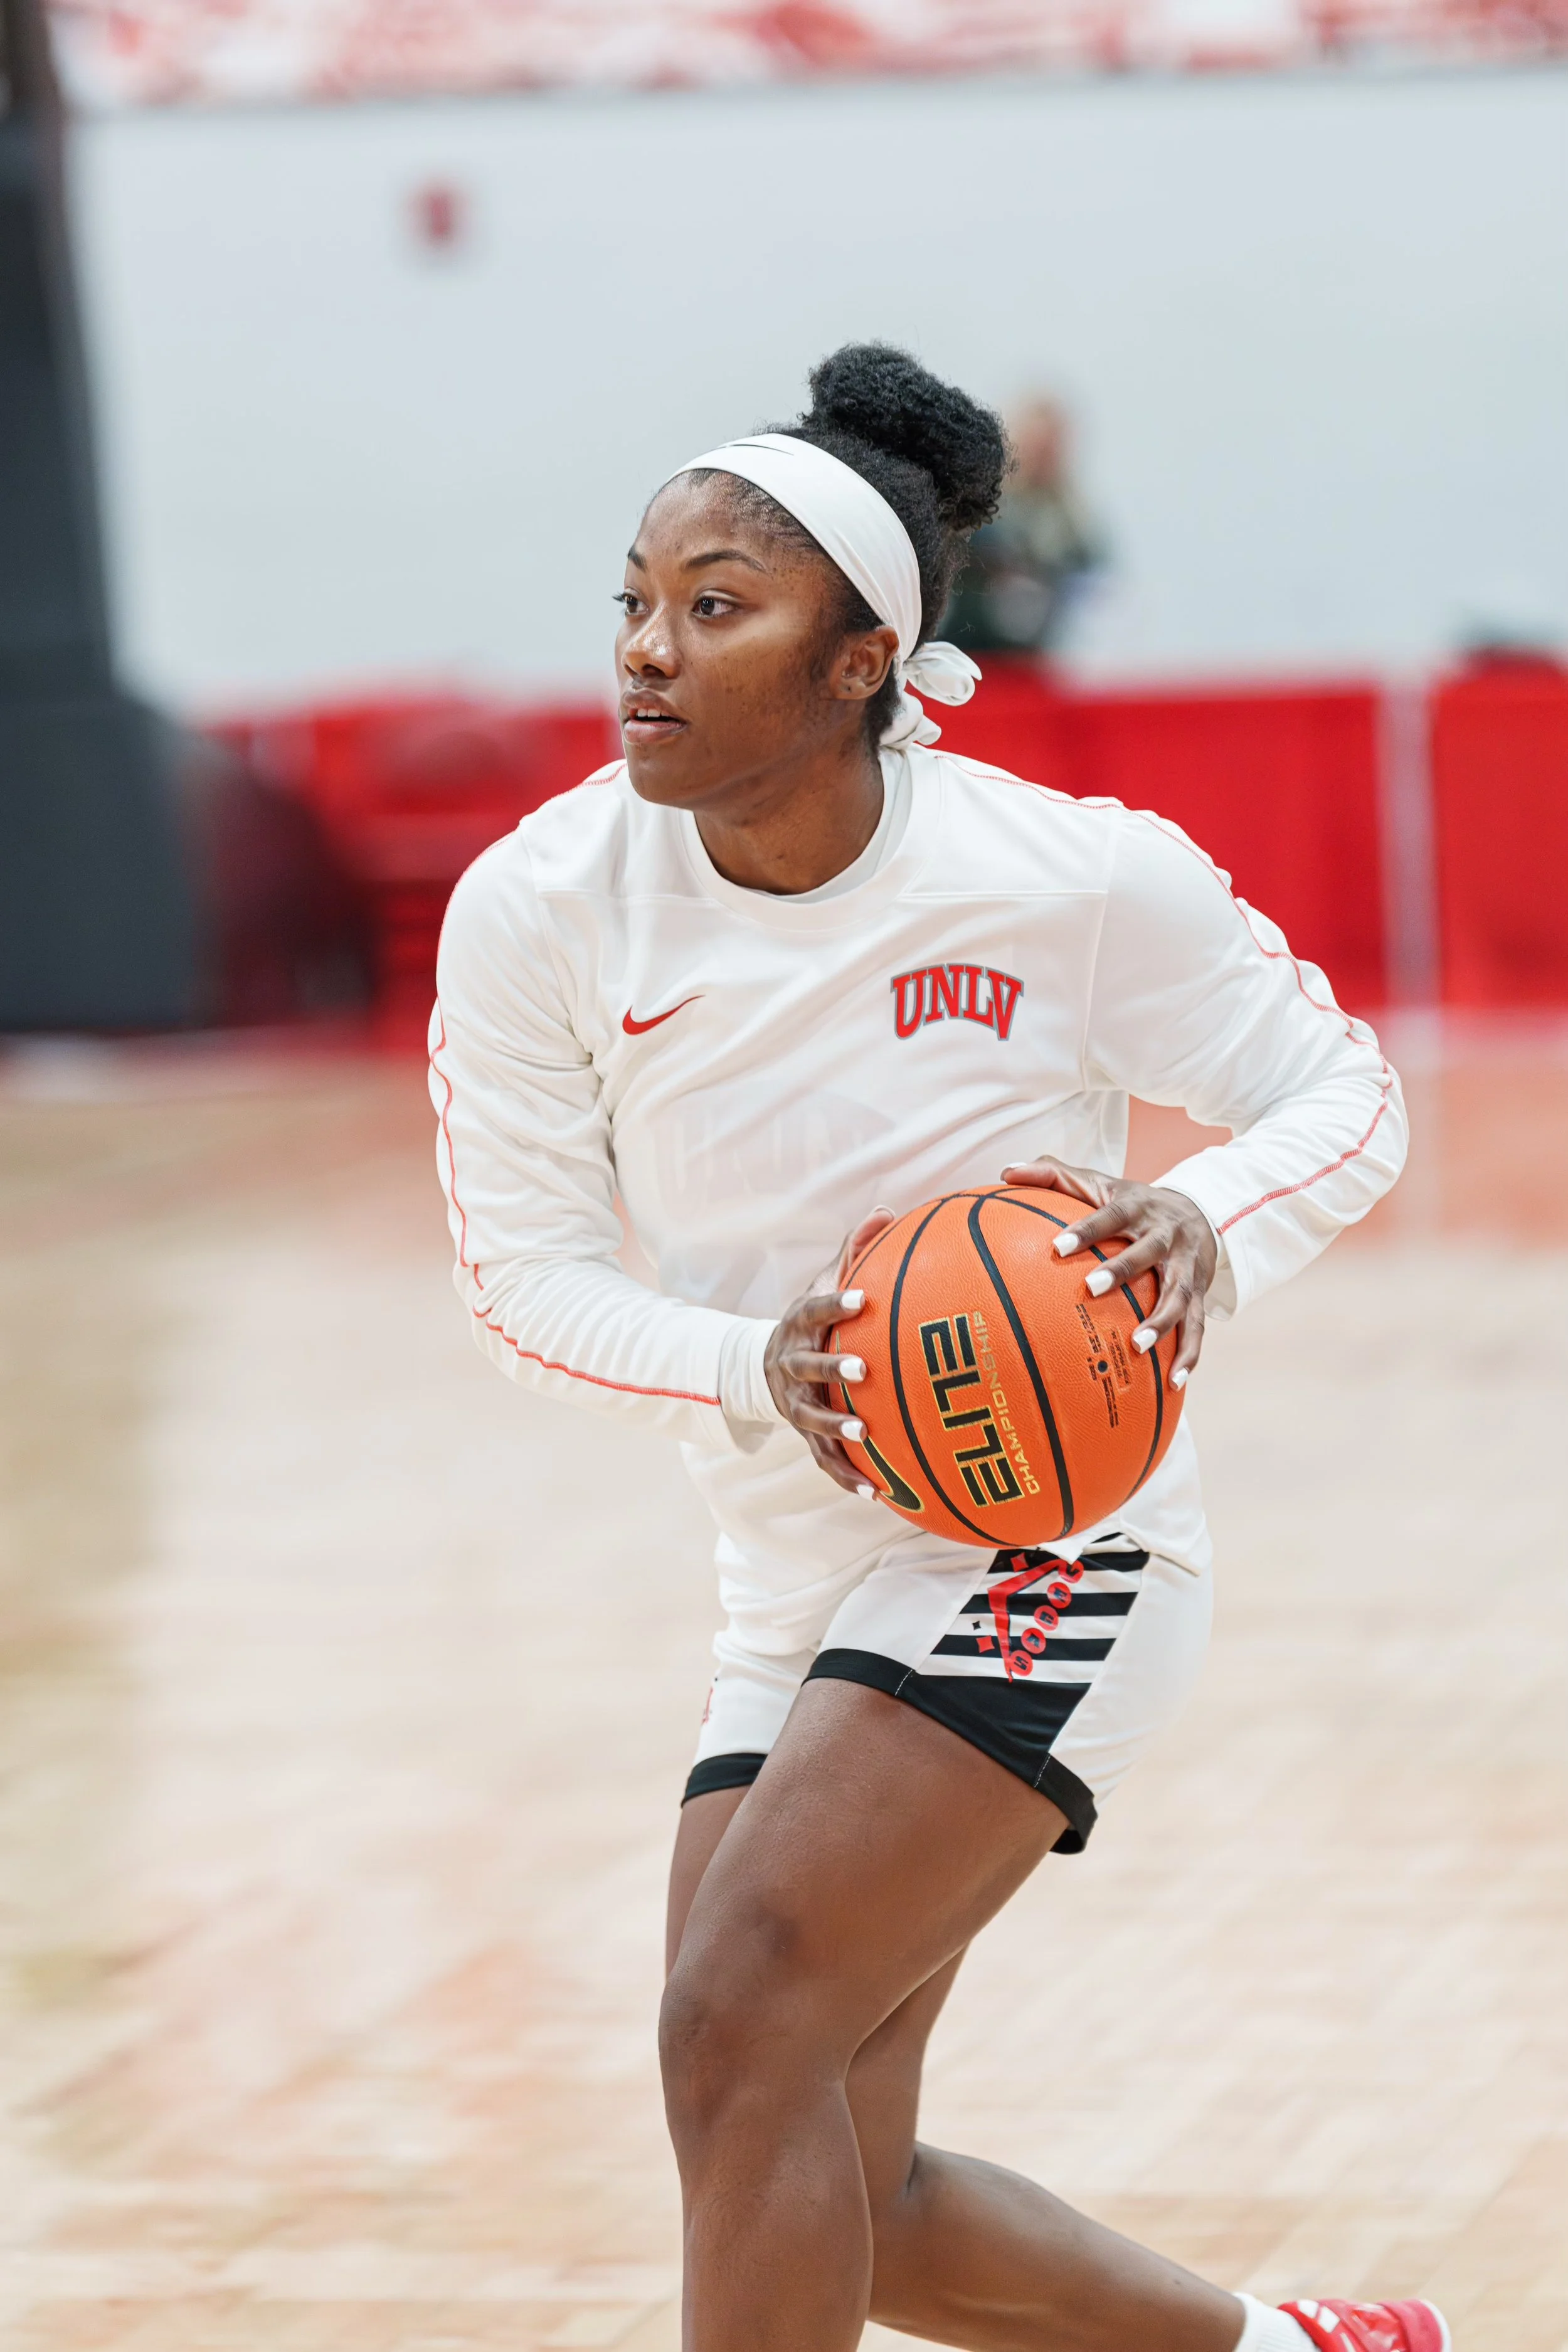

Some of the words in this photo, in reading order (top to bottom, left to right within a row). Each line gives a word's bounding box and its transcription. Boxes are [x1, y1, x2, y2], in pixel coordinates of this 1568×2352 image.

[890, 963, 1024, 1041] UNLV
[918, 1313, 1025, 1508] ELITE
[973, 1310, 1041, 1495] CHAMPIONSHIP
